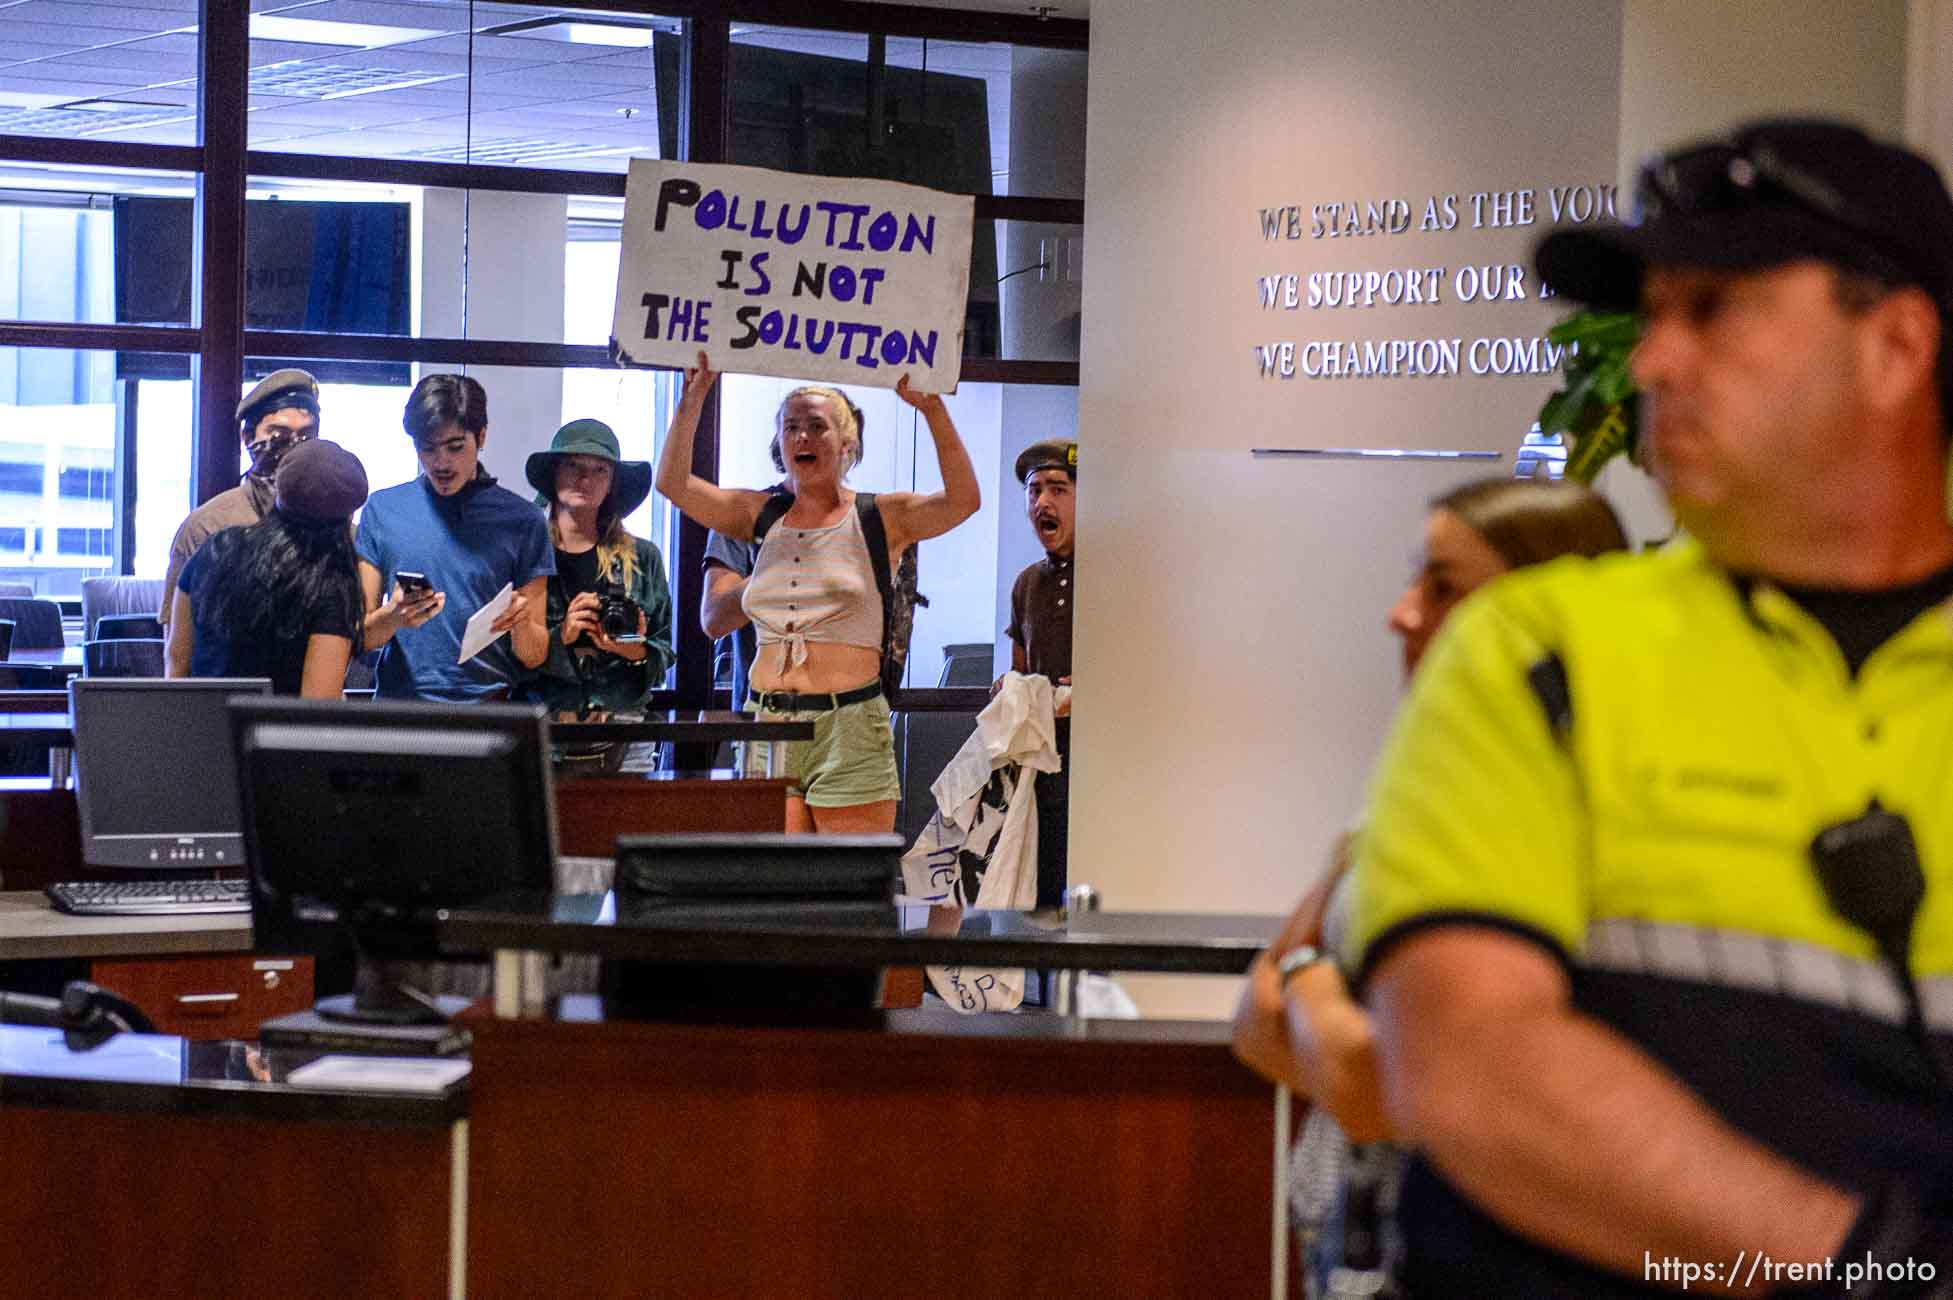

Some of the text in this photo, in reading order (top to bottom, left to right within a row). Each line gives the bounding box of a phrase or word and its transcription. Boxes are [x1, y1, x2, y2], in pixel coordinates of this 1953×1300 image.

[654, 178, 935, 254] POLLUTION
[1260, 206, 1302, 240] WE
[1311, 199, 1411, 239] STAND
[1419, 194, 1458, 231] AS
[1469, 188, 1536, 229] THE
[717, 250, 884, 304] IS NOT
[1258, 274, 1299, 309] WE
[1308, 267, 1445, 308] SUPPORT
[1455, 264, 1526, 301] OUR
[641, 293, 938, 368] THE SOLUTION
[1255, 342, 1295, 378] WE
[1302, 337, 1461, 377] CHAMPION
